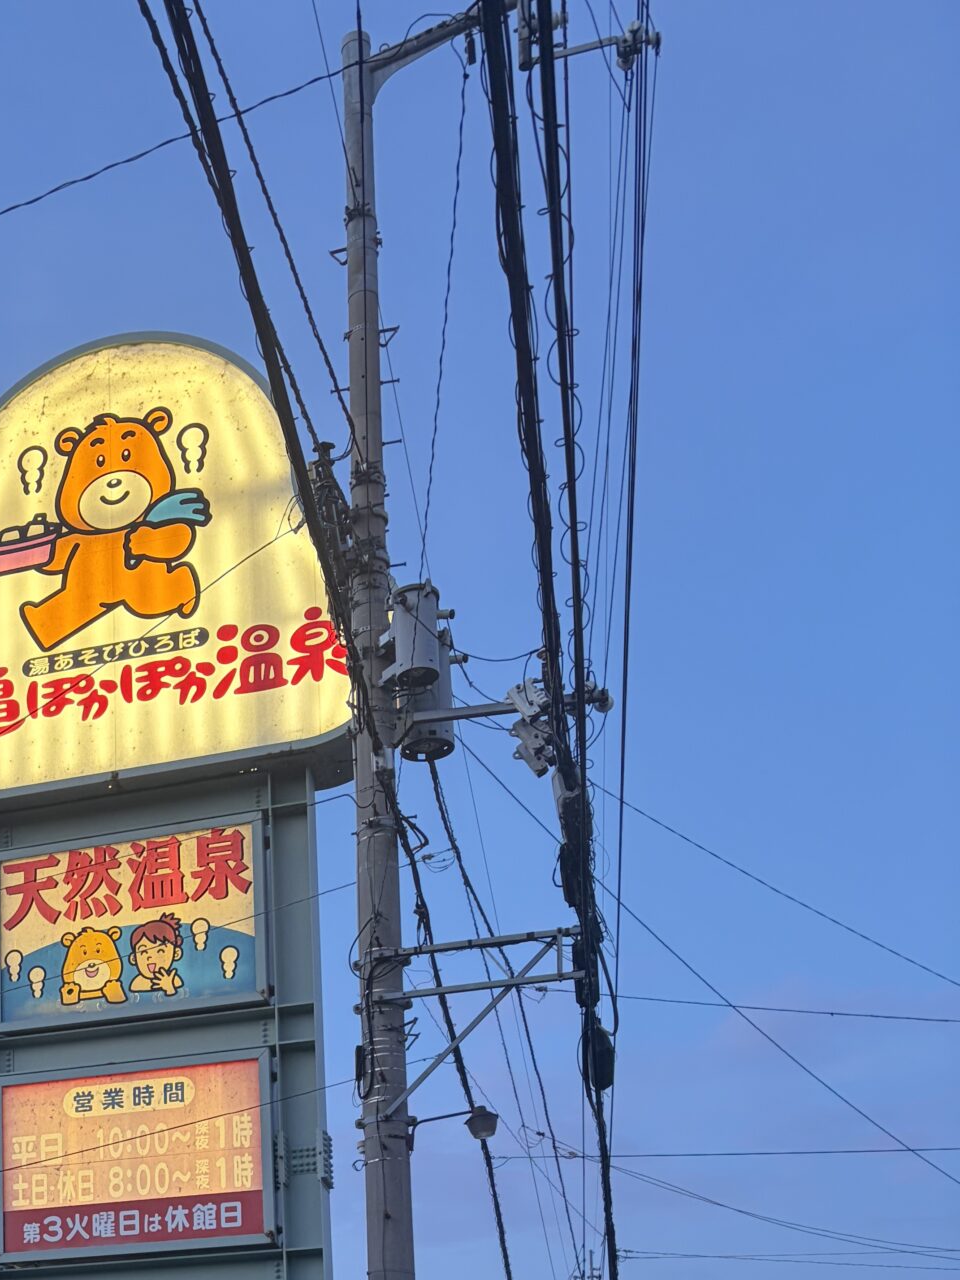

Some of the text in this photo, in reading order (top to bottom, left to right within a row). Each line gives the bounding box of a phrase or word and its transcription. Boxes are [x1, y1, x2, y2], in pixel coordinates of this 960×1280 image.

[29, 628, 201, 677] 湯あそびひろば
[3, 827, 253, 931] 天然温泉
[73, 1081, 186, 1114] 営業時間
[11, 1132, 63, 1170] 平日
[23, 1201, 242, 1244] 第3火曜日は休館日
